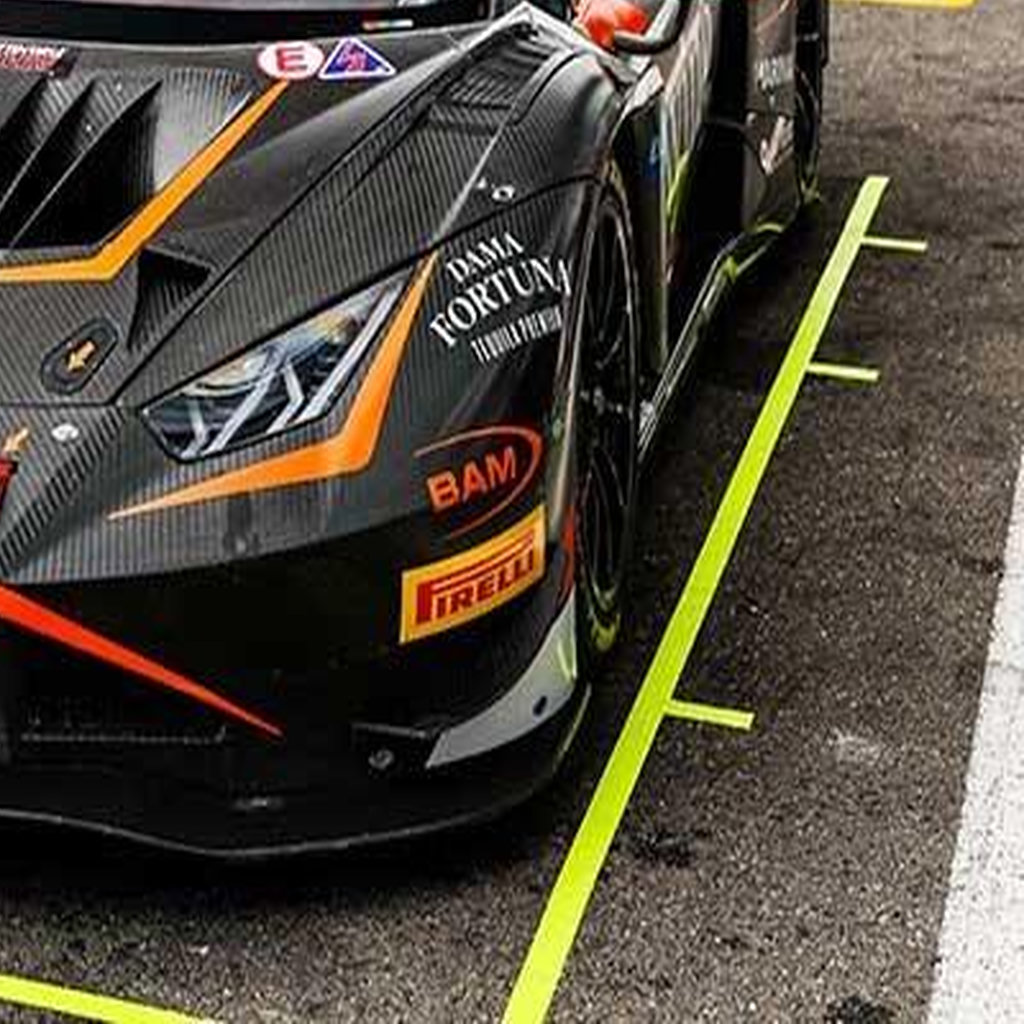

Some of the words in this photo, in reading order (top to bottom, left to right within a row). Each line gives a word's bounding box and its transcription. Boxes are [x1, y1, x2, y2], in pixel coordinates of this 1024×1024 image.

[276, 46, 308, 72] E
[446, 232, 524, 283] DAMA
[427, 445, 518, 513] BAM
[415, 530, 534, 627] PIRELLI
